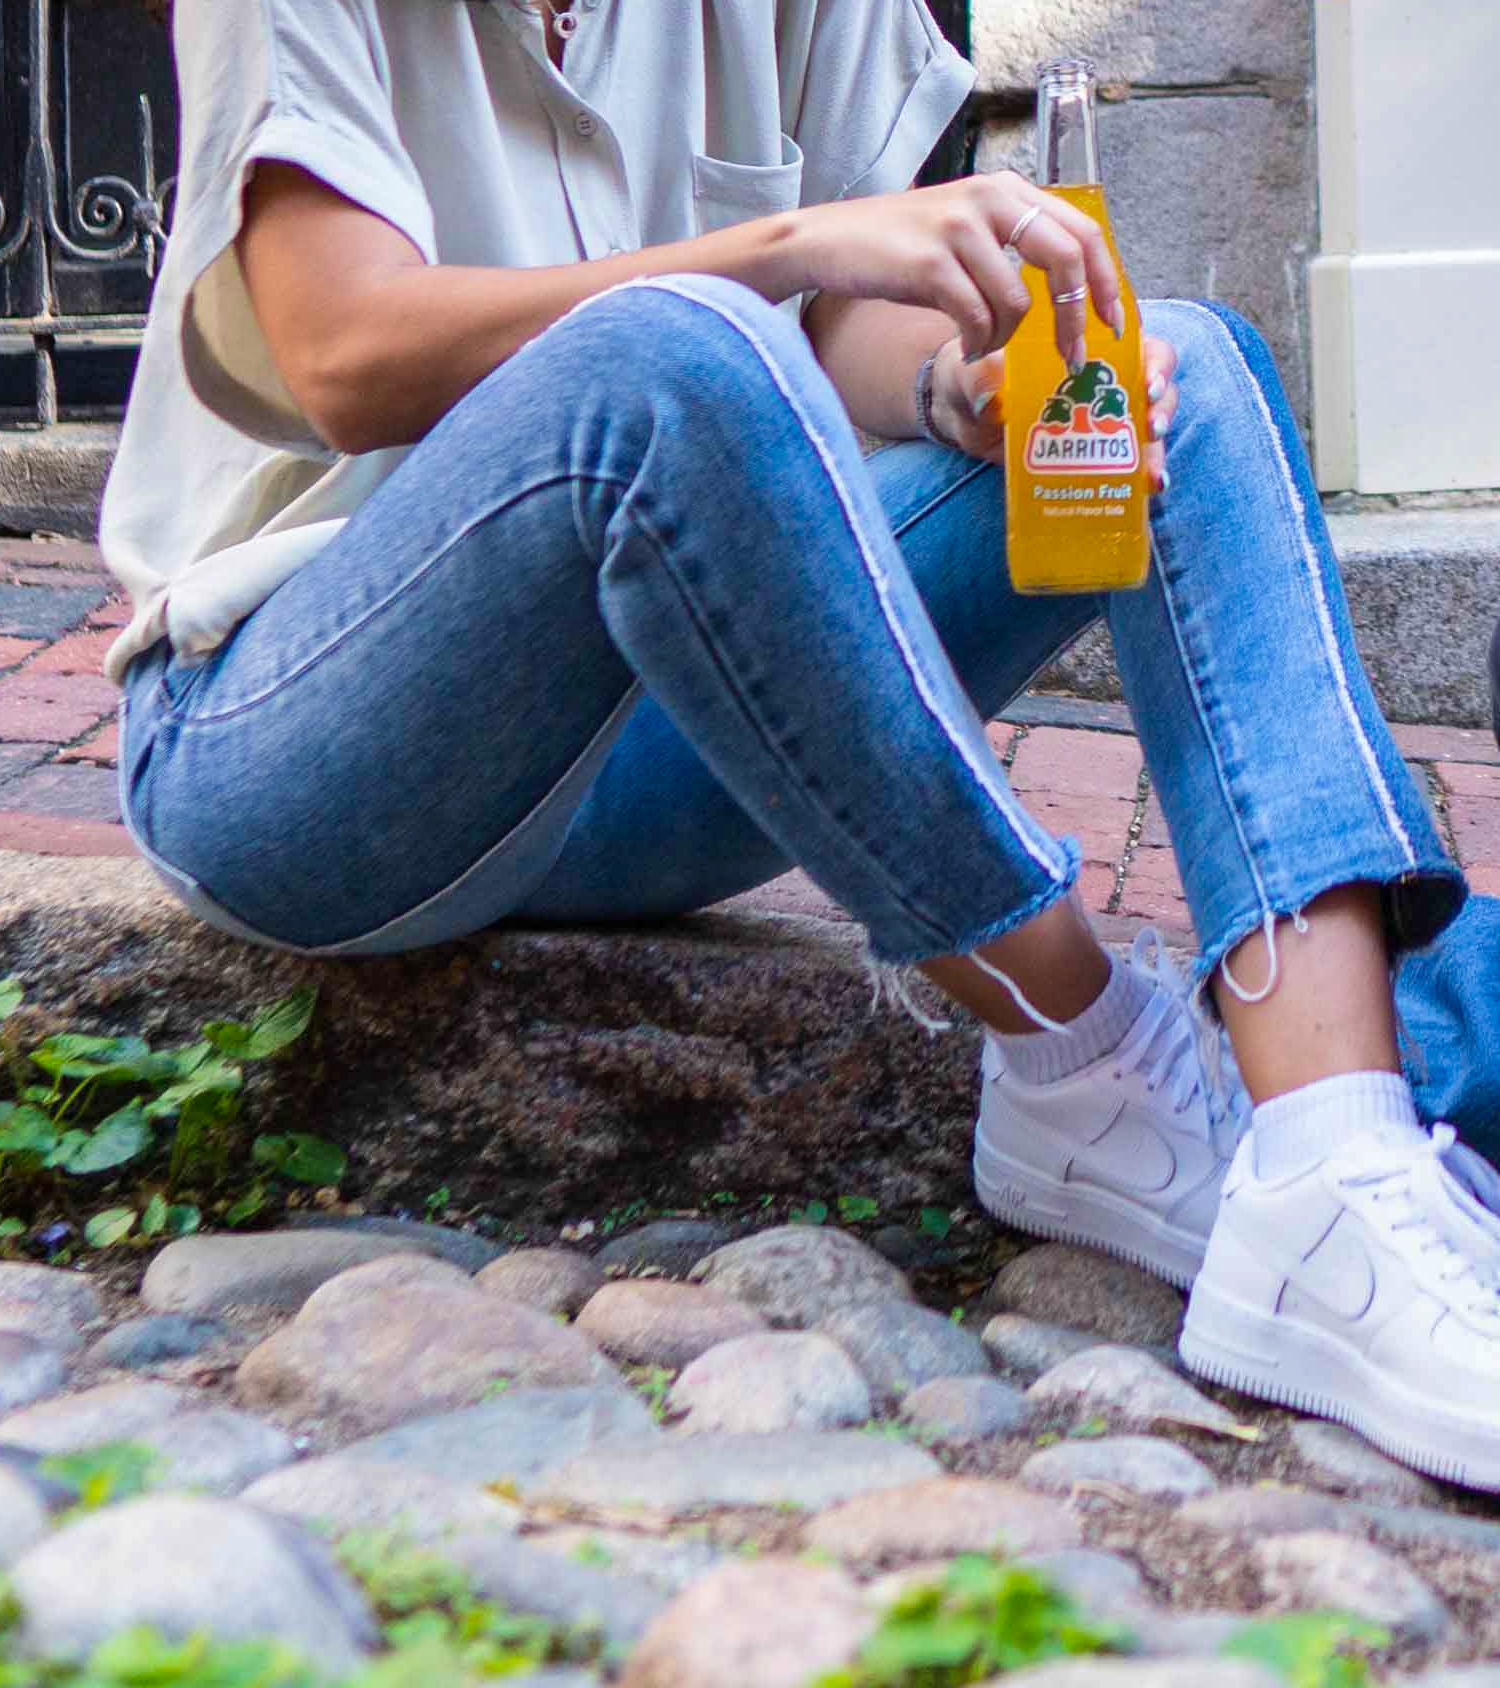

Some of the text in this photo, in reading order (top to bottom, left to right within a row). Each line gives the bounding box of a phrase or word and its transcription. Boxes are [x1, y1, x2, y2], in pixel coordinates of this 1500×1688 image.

[1034, 439, 1129, 458] JARRITOS
[1033, 483, 1132, 499] Passion Fruit
